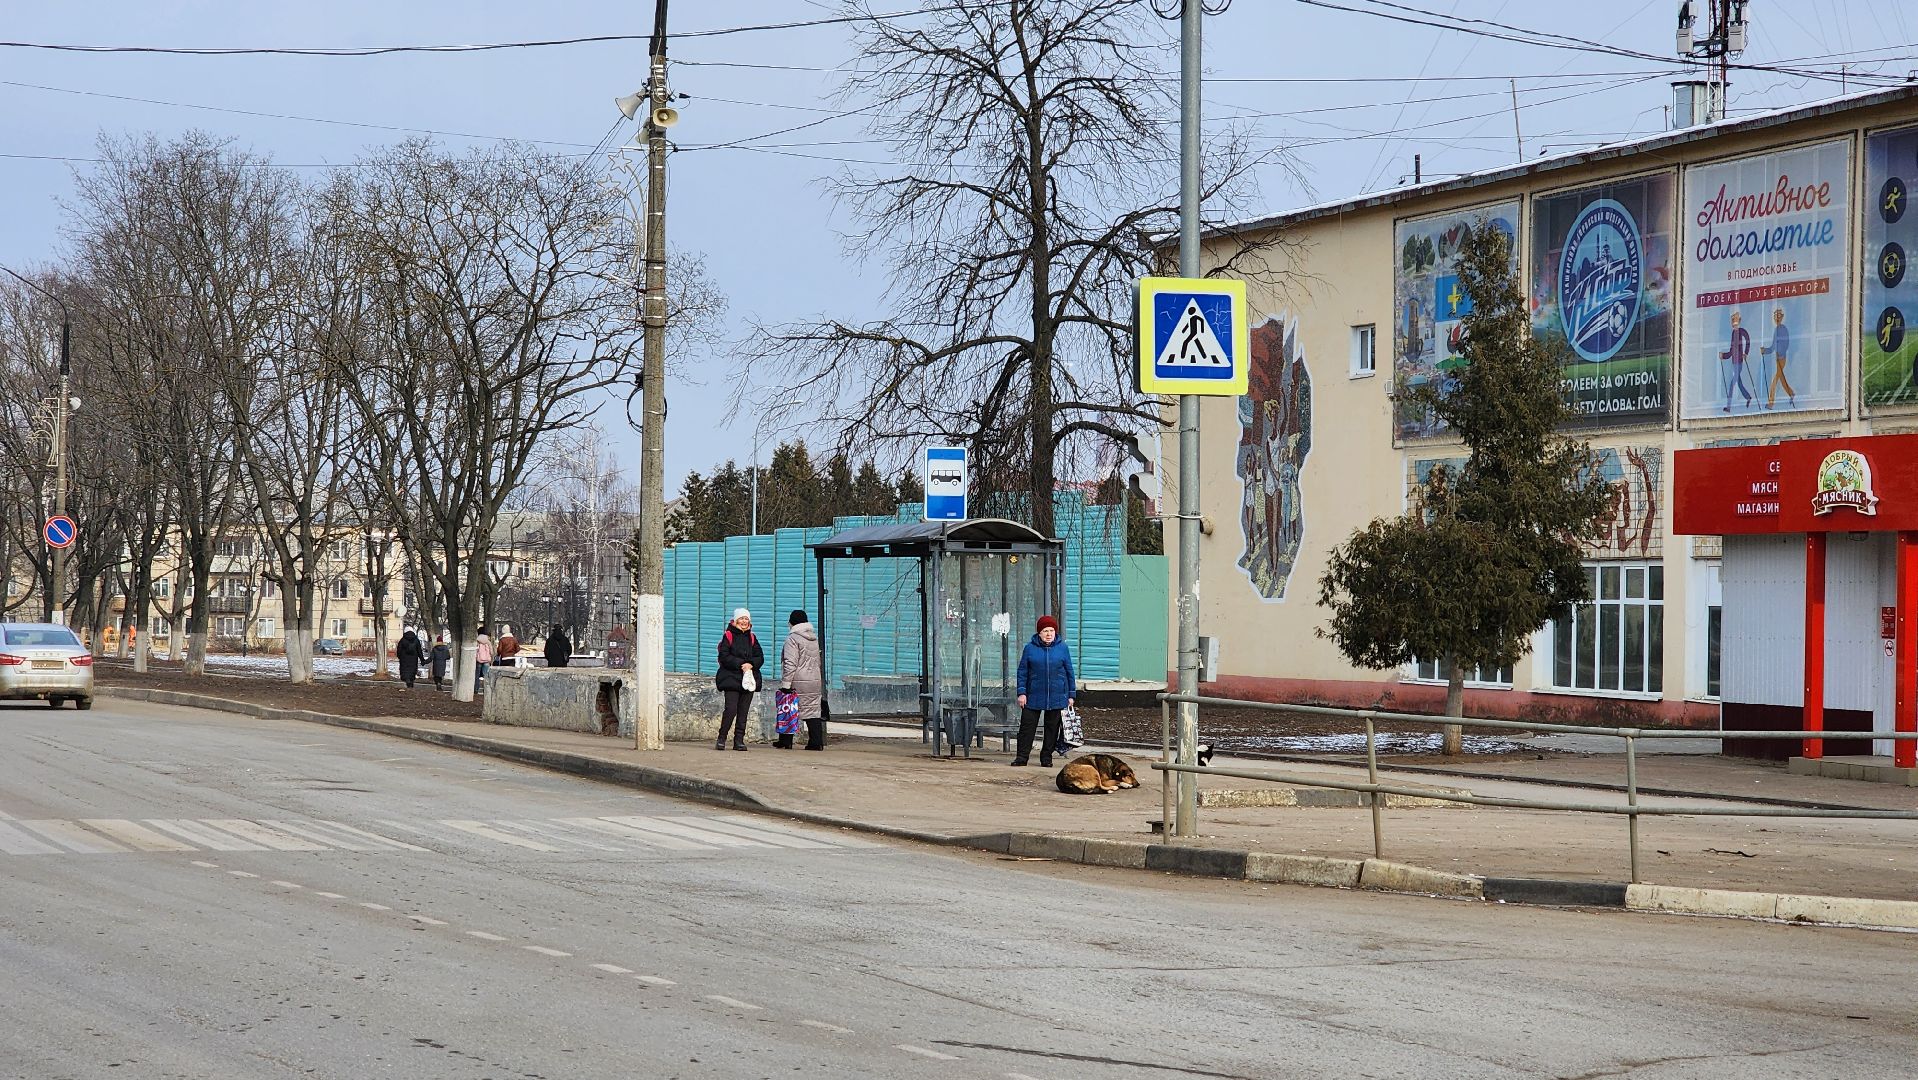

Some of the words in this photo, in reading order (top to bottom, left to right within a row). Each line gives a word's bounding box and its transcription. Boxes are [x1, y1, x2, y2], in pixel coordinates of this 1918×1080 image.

[1697, 174, 1831, 227] Активное
[1696, 219, 1834, 262] долголетие
[1727, 271, 1732, 281] В
[1734, 262, 1797, 280] ПОДМОСКОВЬЕ
[1700, 292, 1740, 305] ПРОЕКТ
[1749, 280, 1828, 298] ГУБЕРНАТОРА
[1600, 375, 1613, 389] ЗА
[1614, 370, 1658, 388] ФУТБОЛ,
[1598, 398, 1636, 413] СЛОВА:
[1637, 393, 1661, 410] ГОЛ!
[1824, 452, 1860, 469] ДОБРЫЙ
[1821, 490, 1863, 505] МЯСНИК
[1737, 502, 1780, 514] МАГАЗИН
